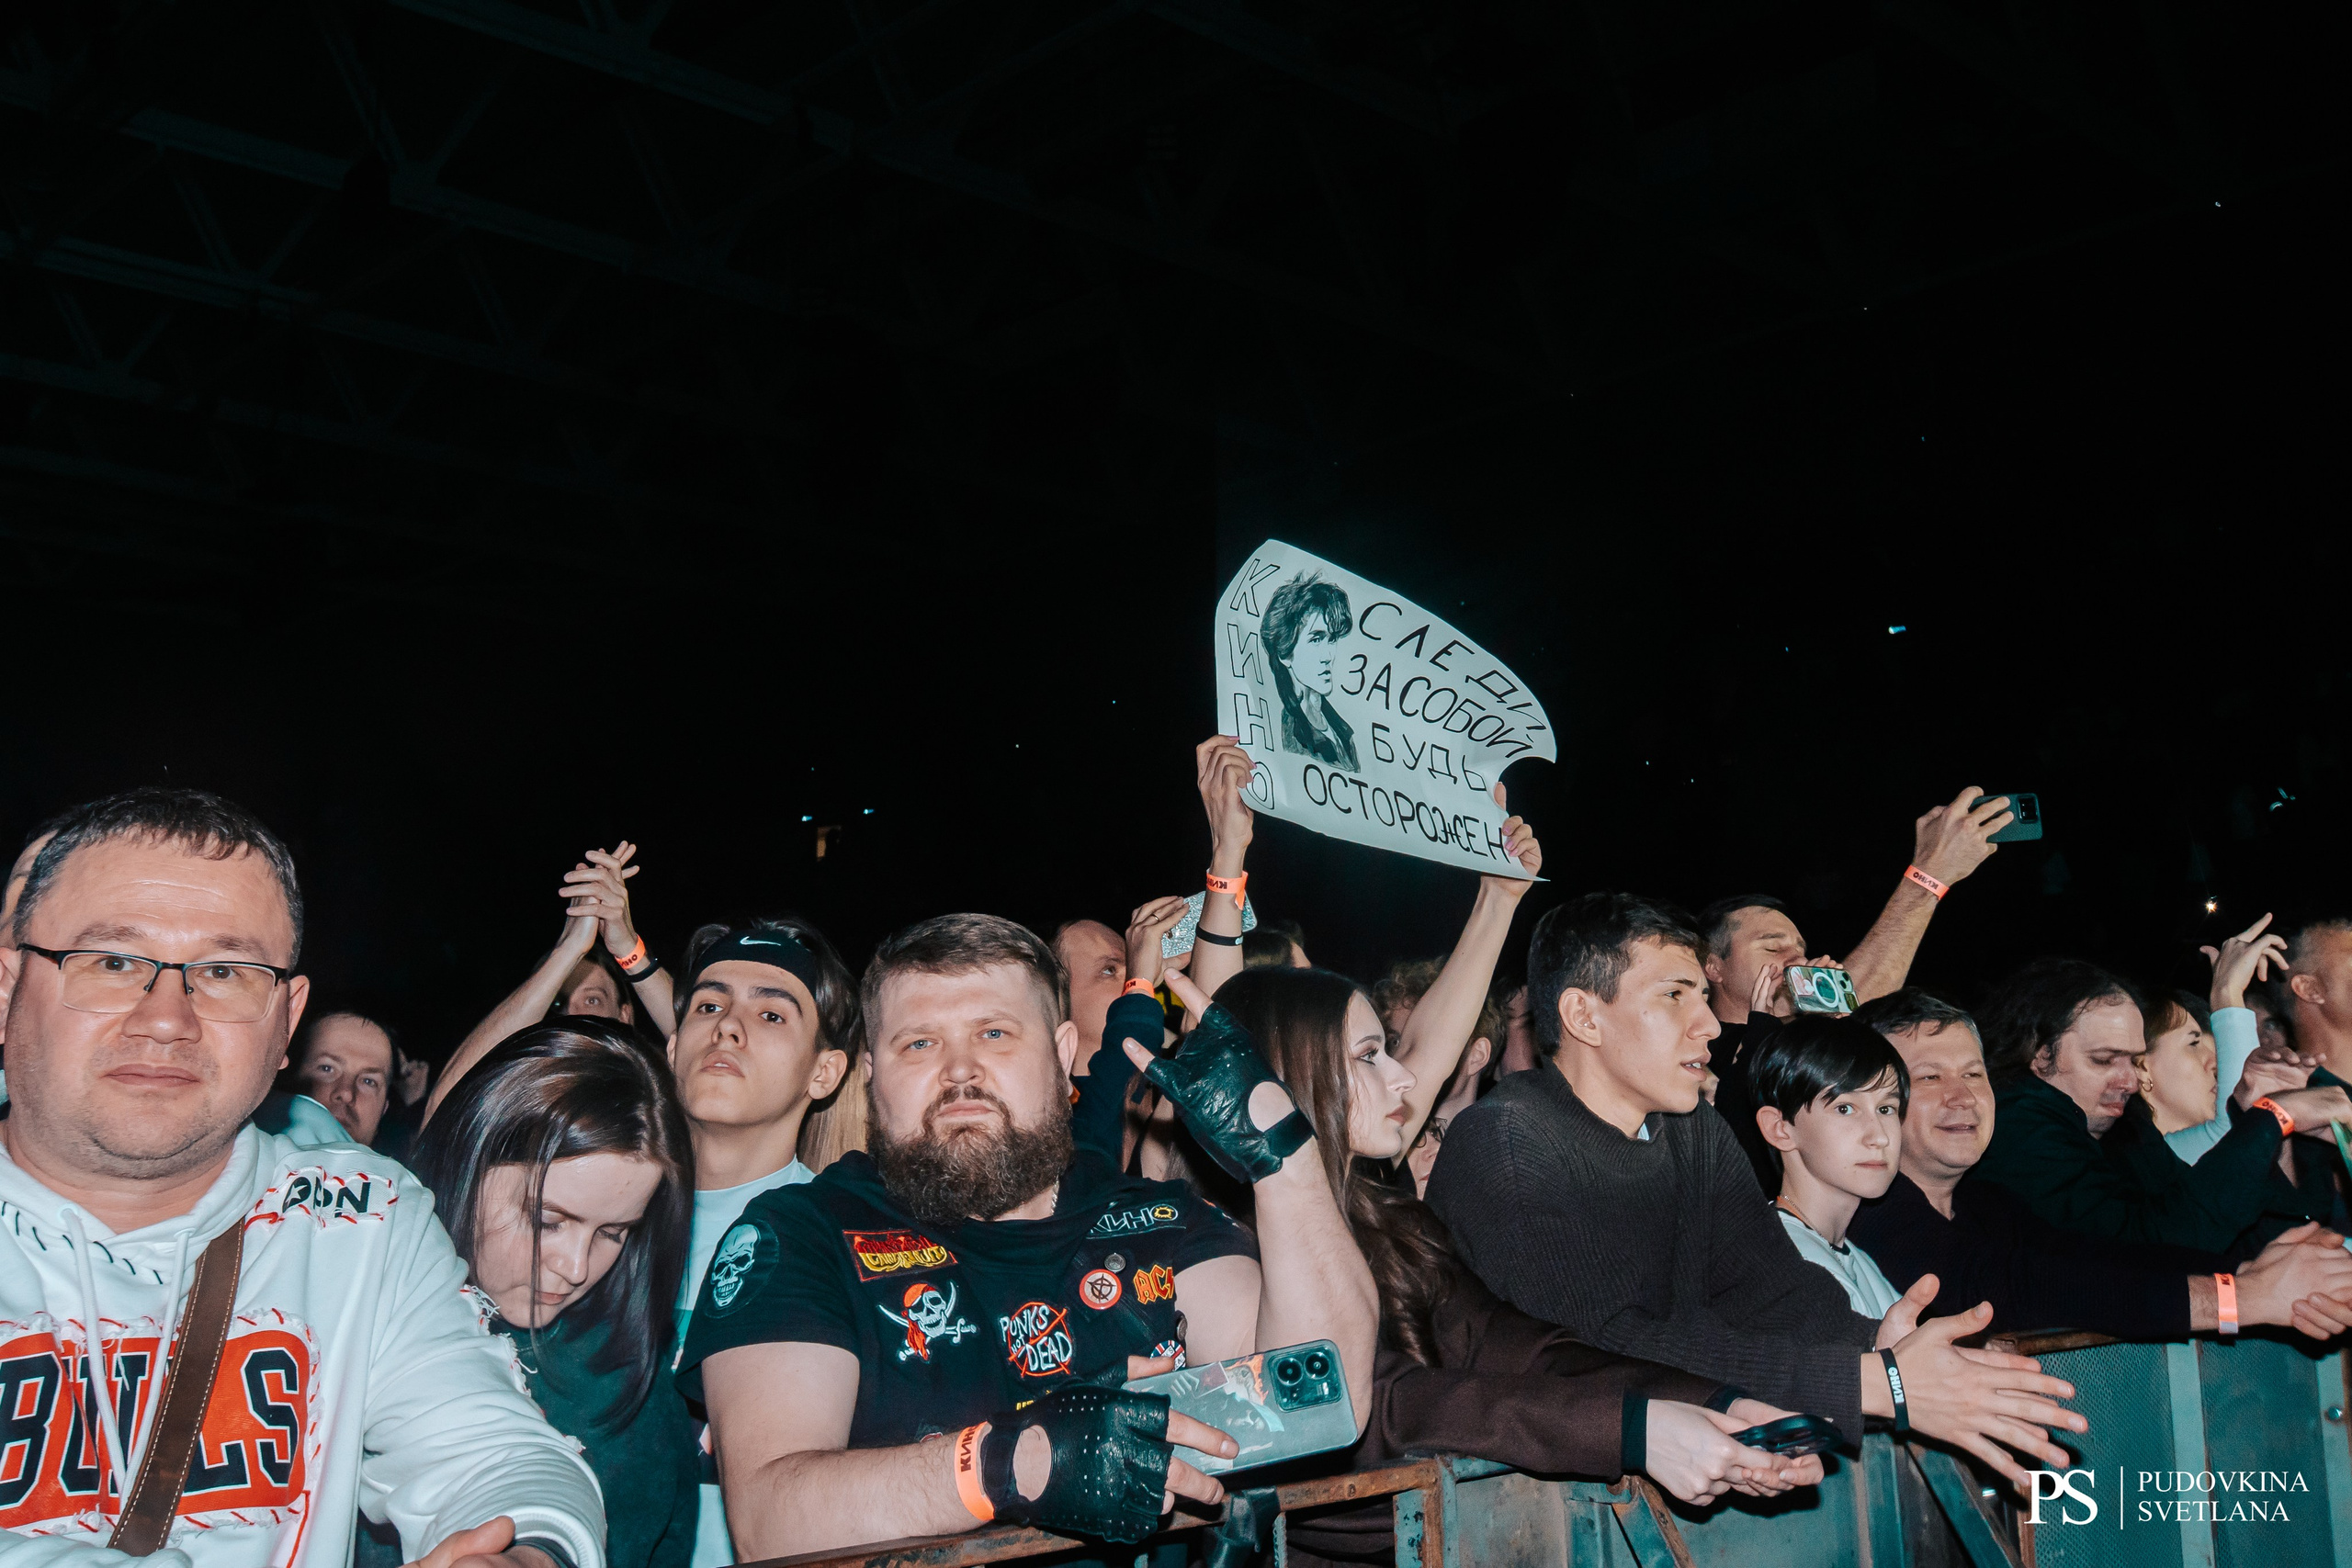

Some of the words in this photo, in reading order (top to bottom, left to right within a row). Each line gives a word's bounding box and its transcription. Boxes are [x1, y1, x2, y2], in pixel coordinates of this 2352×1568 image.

[1229, 558, 1281, 810] КИНО
[1358, 602, 1546, 731] СЛЕДИ
[1371, 722, 1487, 792] БУДЬ
[1303, 763, 1511, 863] ОСТОРОЖЕН
[1207, 878, 1227, 889] КИН
[1913, 872, 1939, 890] КИНО
[620, 953, 639, 967] ИНО
[999, 1304, 1049, 1342] PUNKS
[1025, 1331, 1072, 1371] DEAD
[1888, 1366, 1905, 1404] КИНО
[0, 1347, 300, 1510] BULS
